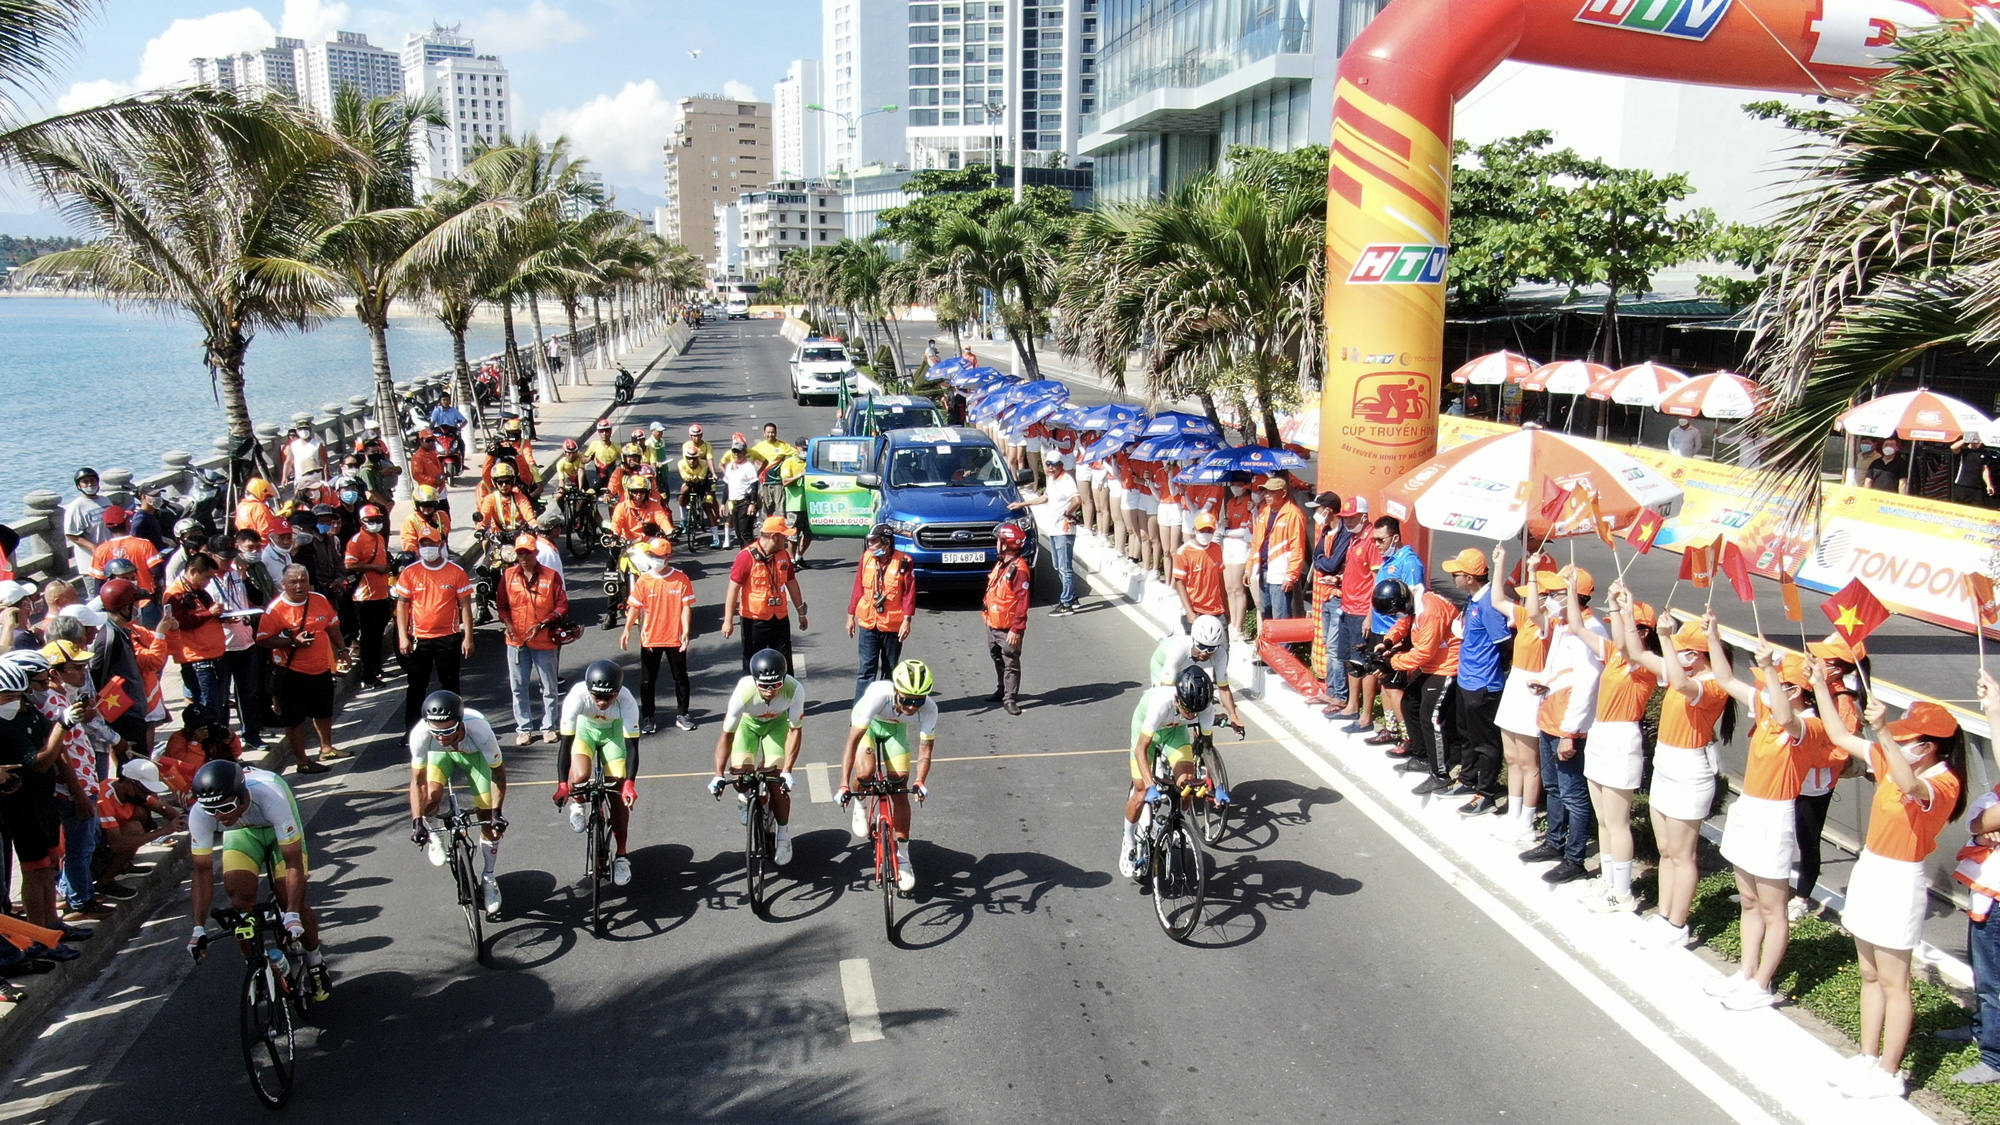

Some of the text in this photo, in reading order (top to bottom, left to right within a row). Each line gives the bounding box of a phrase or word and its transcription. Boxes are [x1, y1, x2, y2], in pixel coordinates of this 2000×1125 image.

[1349, 249, 1447, 279] HTV
[1363, 354, 1395, 364] HTV
[1341, 423, 1366, 436] CÚP
[1207, 458, 1233, 467] HTV
[1369, 465, 1417, 475] 202
[1622, 467, 1645, 481] HTV
[1458, 476, 1510, 492] HTV
[809, 501, 846, 514] HELP
[1443, 512, 1488, 531] HTV
[1711, 508, 1750, 529] HTV
[1847, 547, 1970, 602] TON DON
